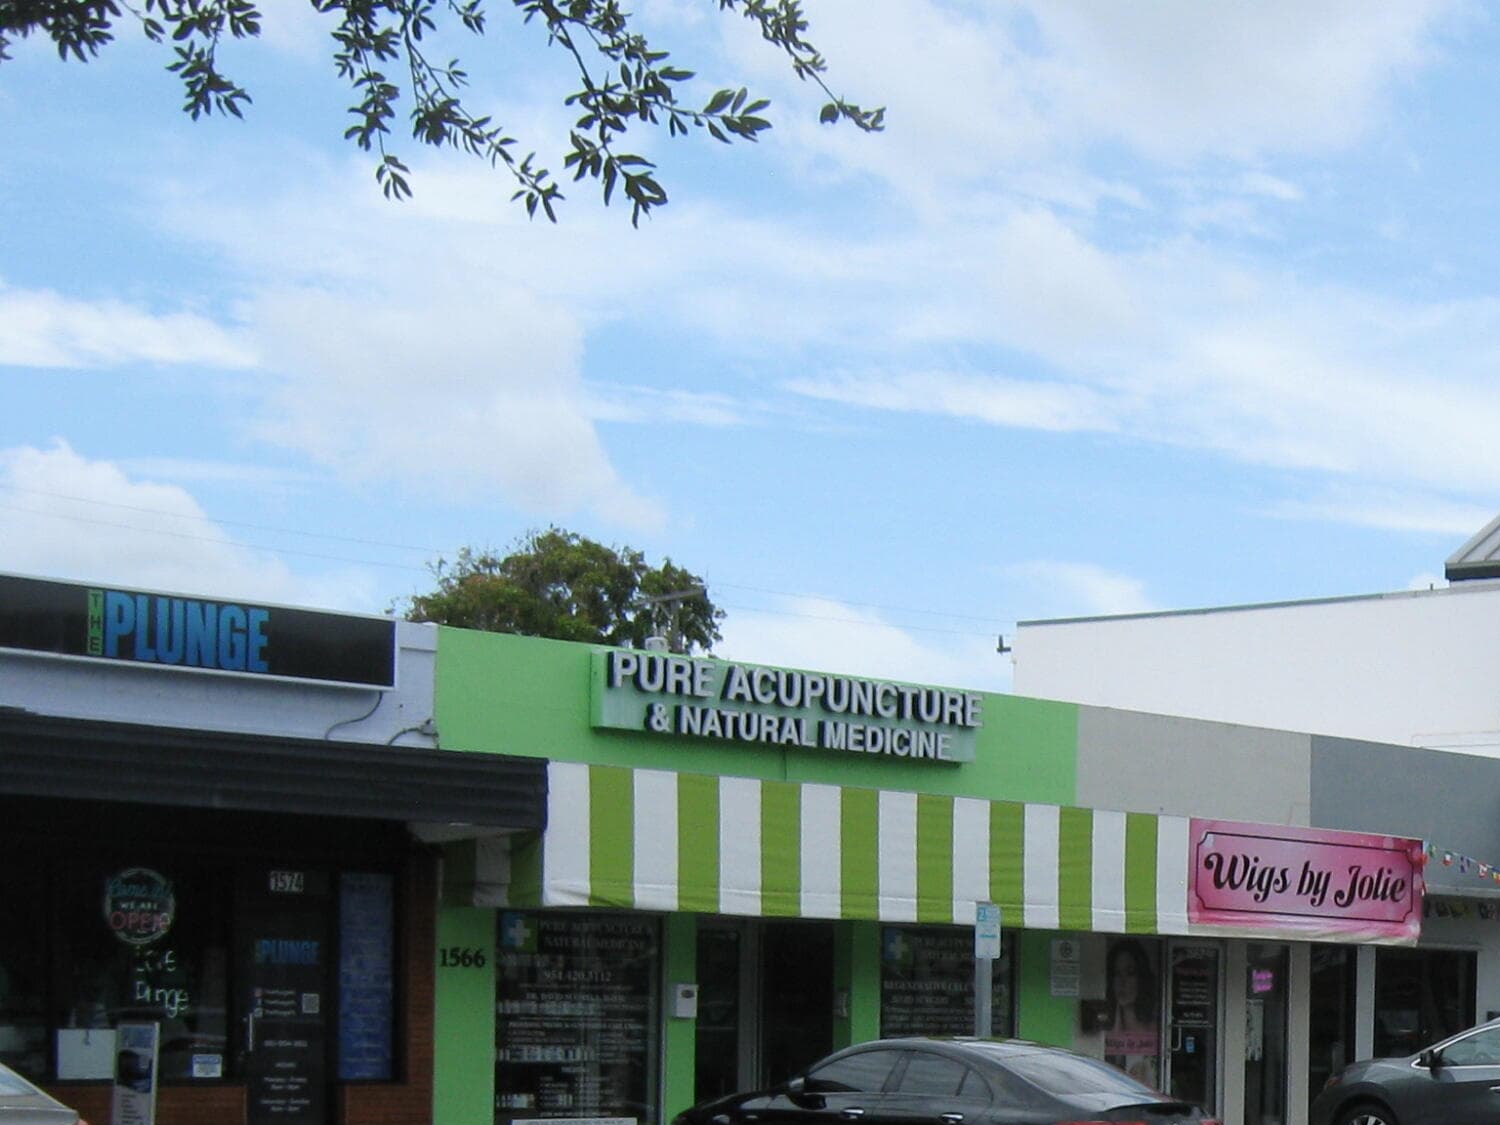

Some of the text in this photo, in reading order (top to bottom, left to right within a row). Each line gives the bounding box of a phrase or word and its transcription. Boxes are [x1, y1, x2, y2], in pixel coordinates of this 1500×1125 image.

[90, 592, 101, 652] THE
[104, 591, 270, 673] PLUNGE
[609, 650, 983, 728] PURE ACUPUNCTURE
[648, 702, 953, 760] & NATURAL MEDICINE
[1204, 852, 1405, 908] Wigs by Jolie
[111, 912, 170, 931] OPEN
[261, 939, 320, 964] PLUNGE
[440, 948, 485, 968] 1566
